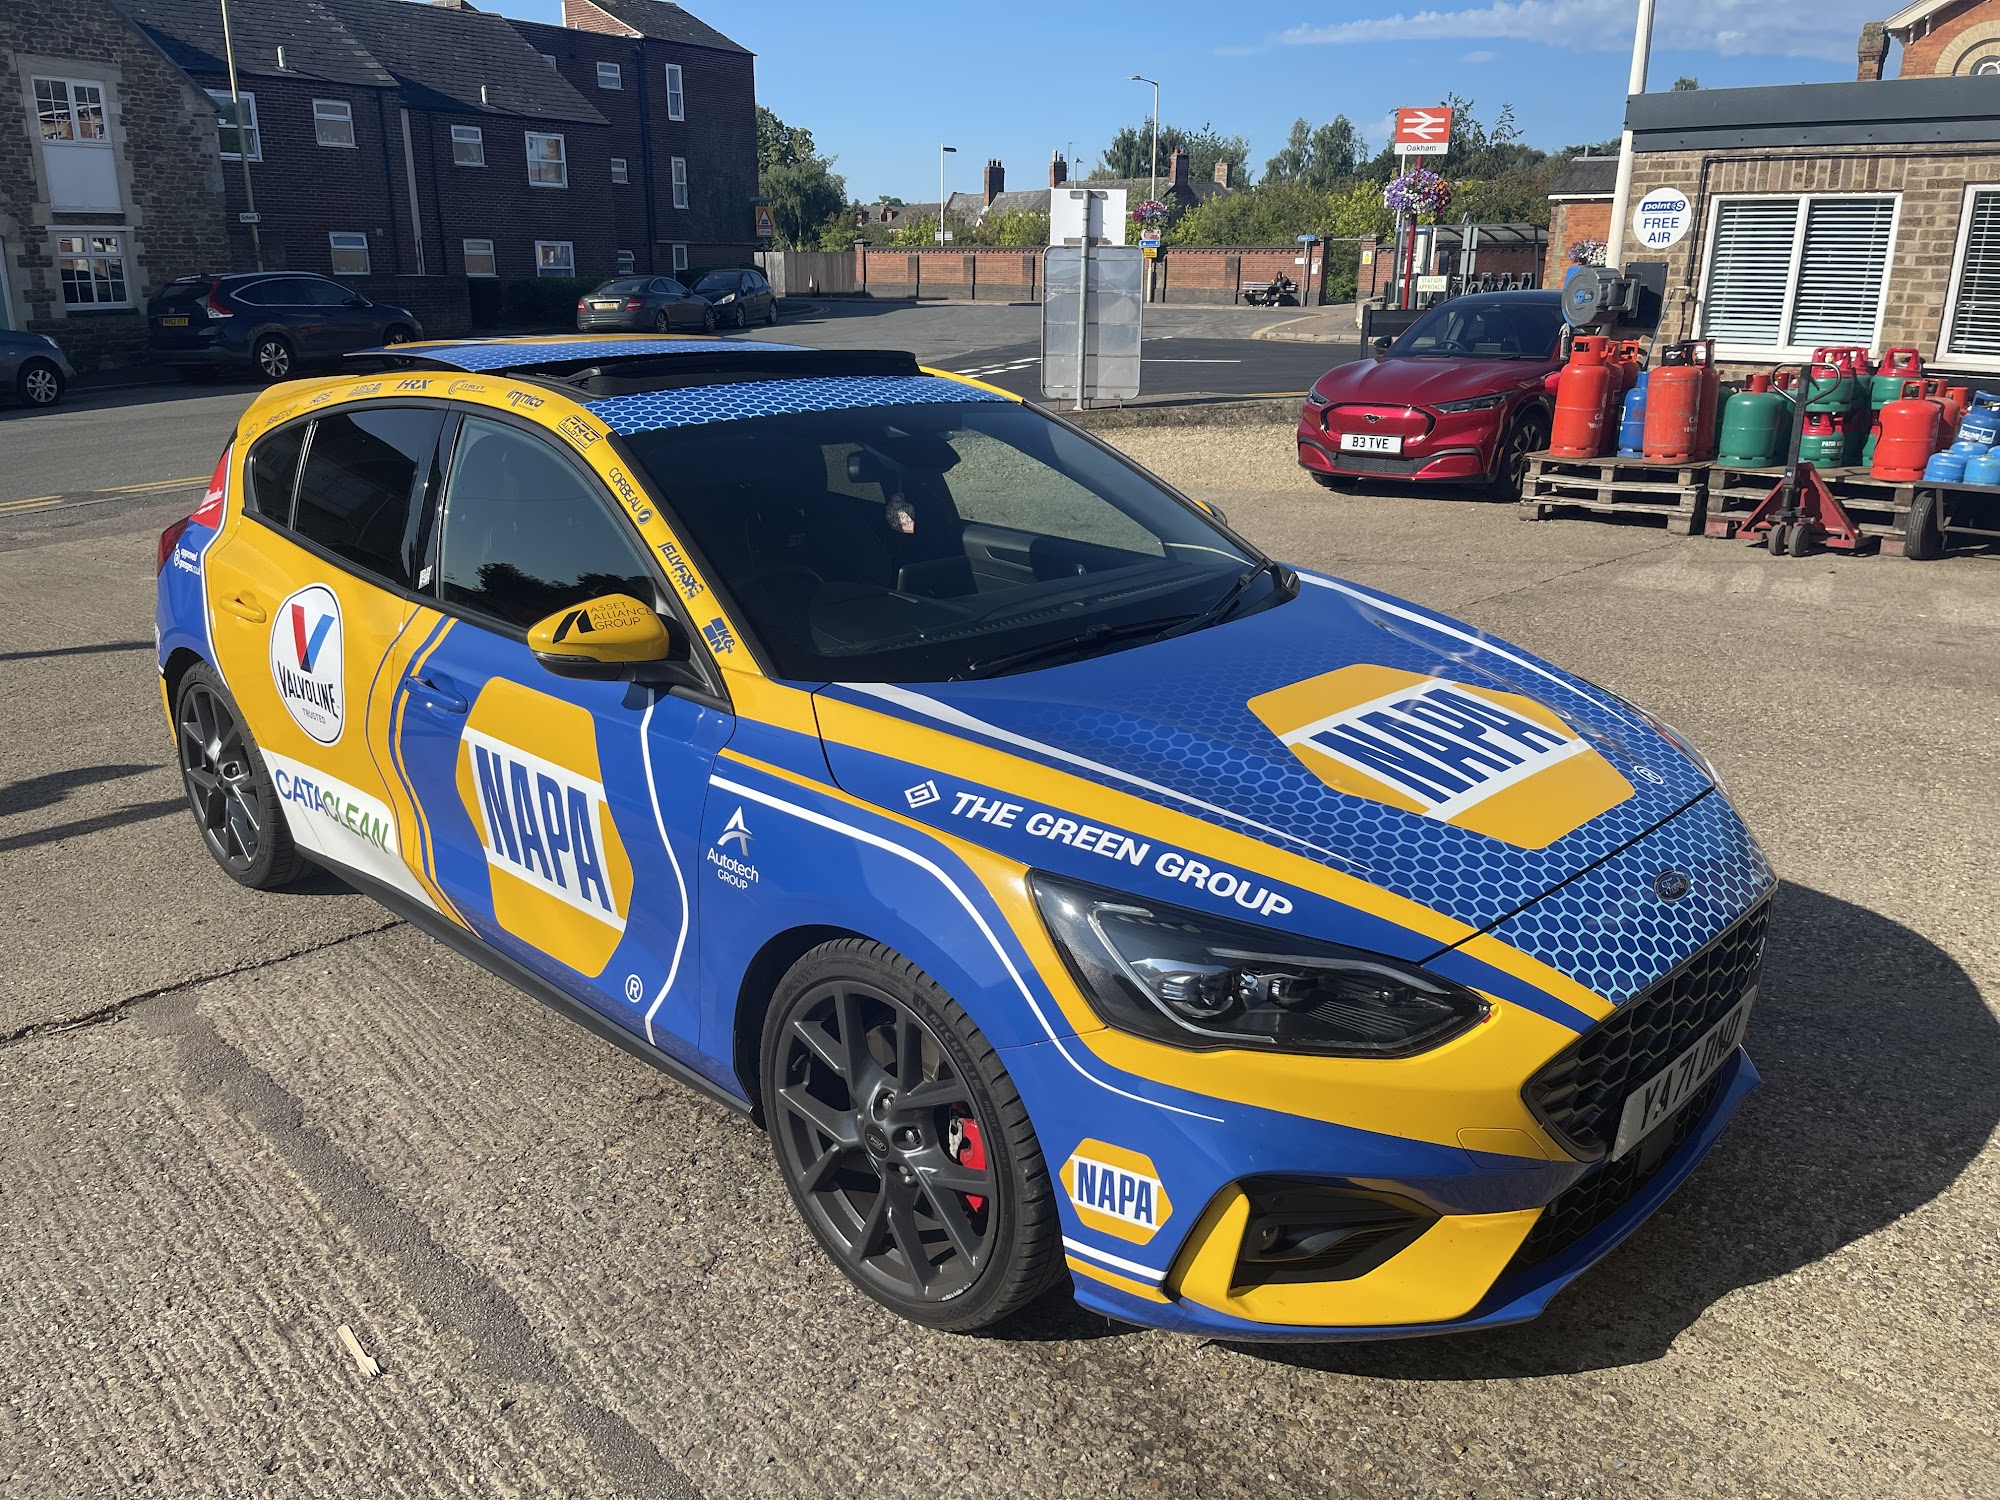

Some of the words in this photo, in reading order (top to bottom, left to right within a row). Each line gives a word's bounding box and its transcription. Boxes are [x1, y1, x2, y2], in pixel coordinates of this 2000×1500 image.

[1406, 144, 1437, 152] Oakham
[1643, 217, 1680, 229] FREE
[1647, 232, 1671, 243] AIR
[1352, 436, 1366, 448] B3
[1369, 437, 1389, 450] TVE
[608, 467, 643, 512] CORBEAU
[591, 601, 626, 613] ASSET
[593, 607, 653, 621] ALLIANCE
[594, 616, 641, 630] GROUP
[277, 660, 339, 720] VALVOLINE
[301, 707, 326, 725] TRUSTED
[1308, 688, 1568, 805] NAPA
[275, 768, 389, 855] CATACLEAN
[474, 744, 612, 914] NAPA
[706, 847, 759, 884] Autotech
[950, 791, 1024, 829] THE
[1025, 812, 1150, 867] GREEN
[1154, 852, 1293, 918] GROUP
[717, 868, 749, 890] GROUP
[928, 1011, 985, 1091] MICHELIN
[1640, 1047, 1700, 1132] YA71
[983, 1100, 998, 1130] PILOT
[1078, 1161, 1153, 1225] NAPA
